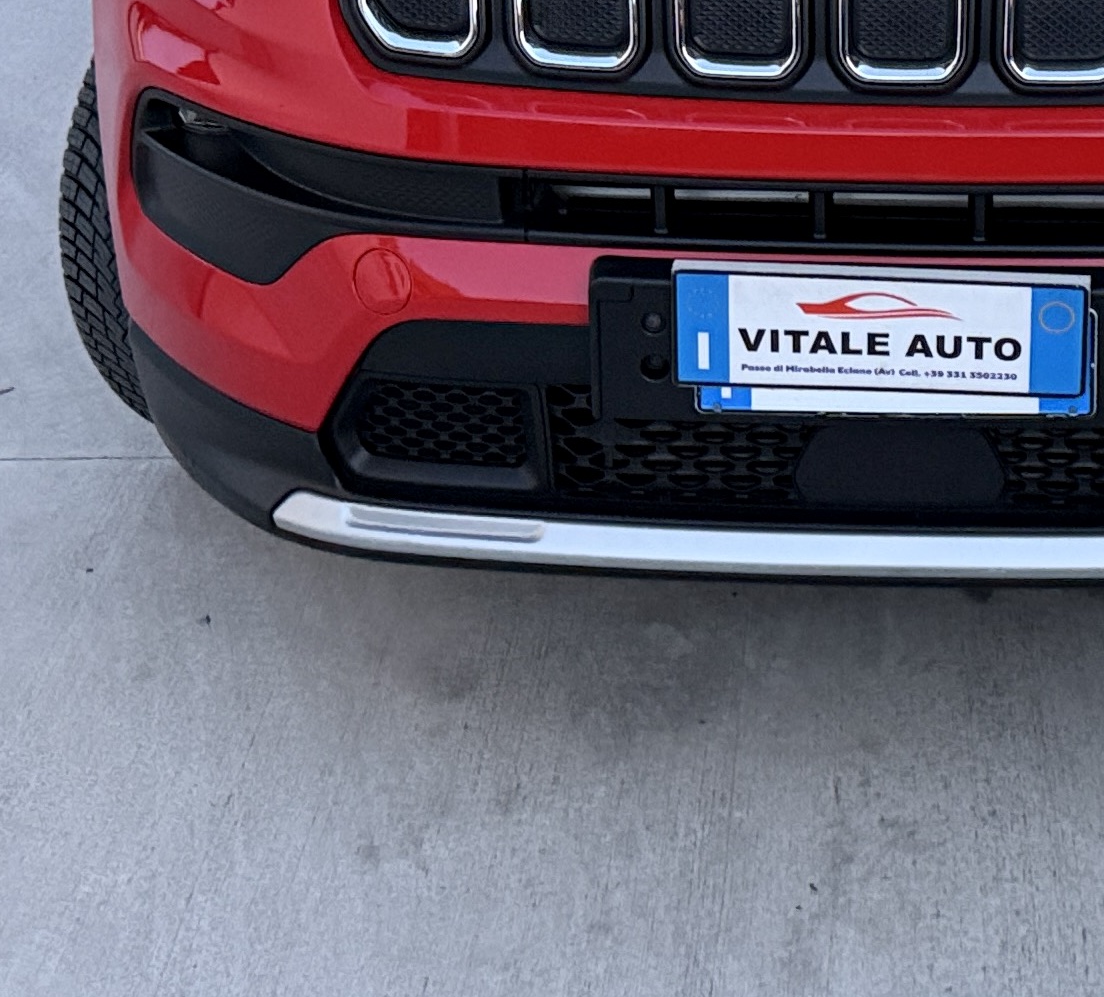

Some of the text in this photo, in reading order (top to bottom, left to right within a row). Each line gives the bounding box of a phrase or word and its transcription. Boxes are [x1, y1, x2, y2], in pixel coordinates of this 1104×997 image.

[738, 327, 1022, 361] VITALE AUTO
[741, 363, 772, 372] Passo
[774, 364, 784, 372] di
[786, 365, 836, 374] Mirabella
[838, 366, 873, 375] Eclano
[874, 367, 896, 376] (Av)
[924, 370, 944, 378] +39
[946, 370, 968, 379] 331
